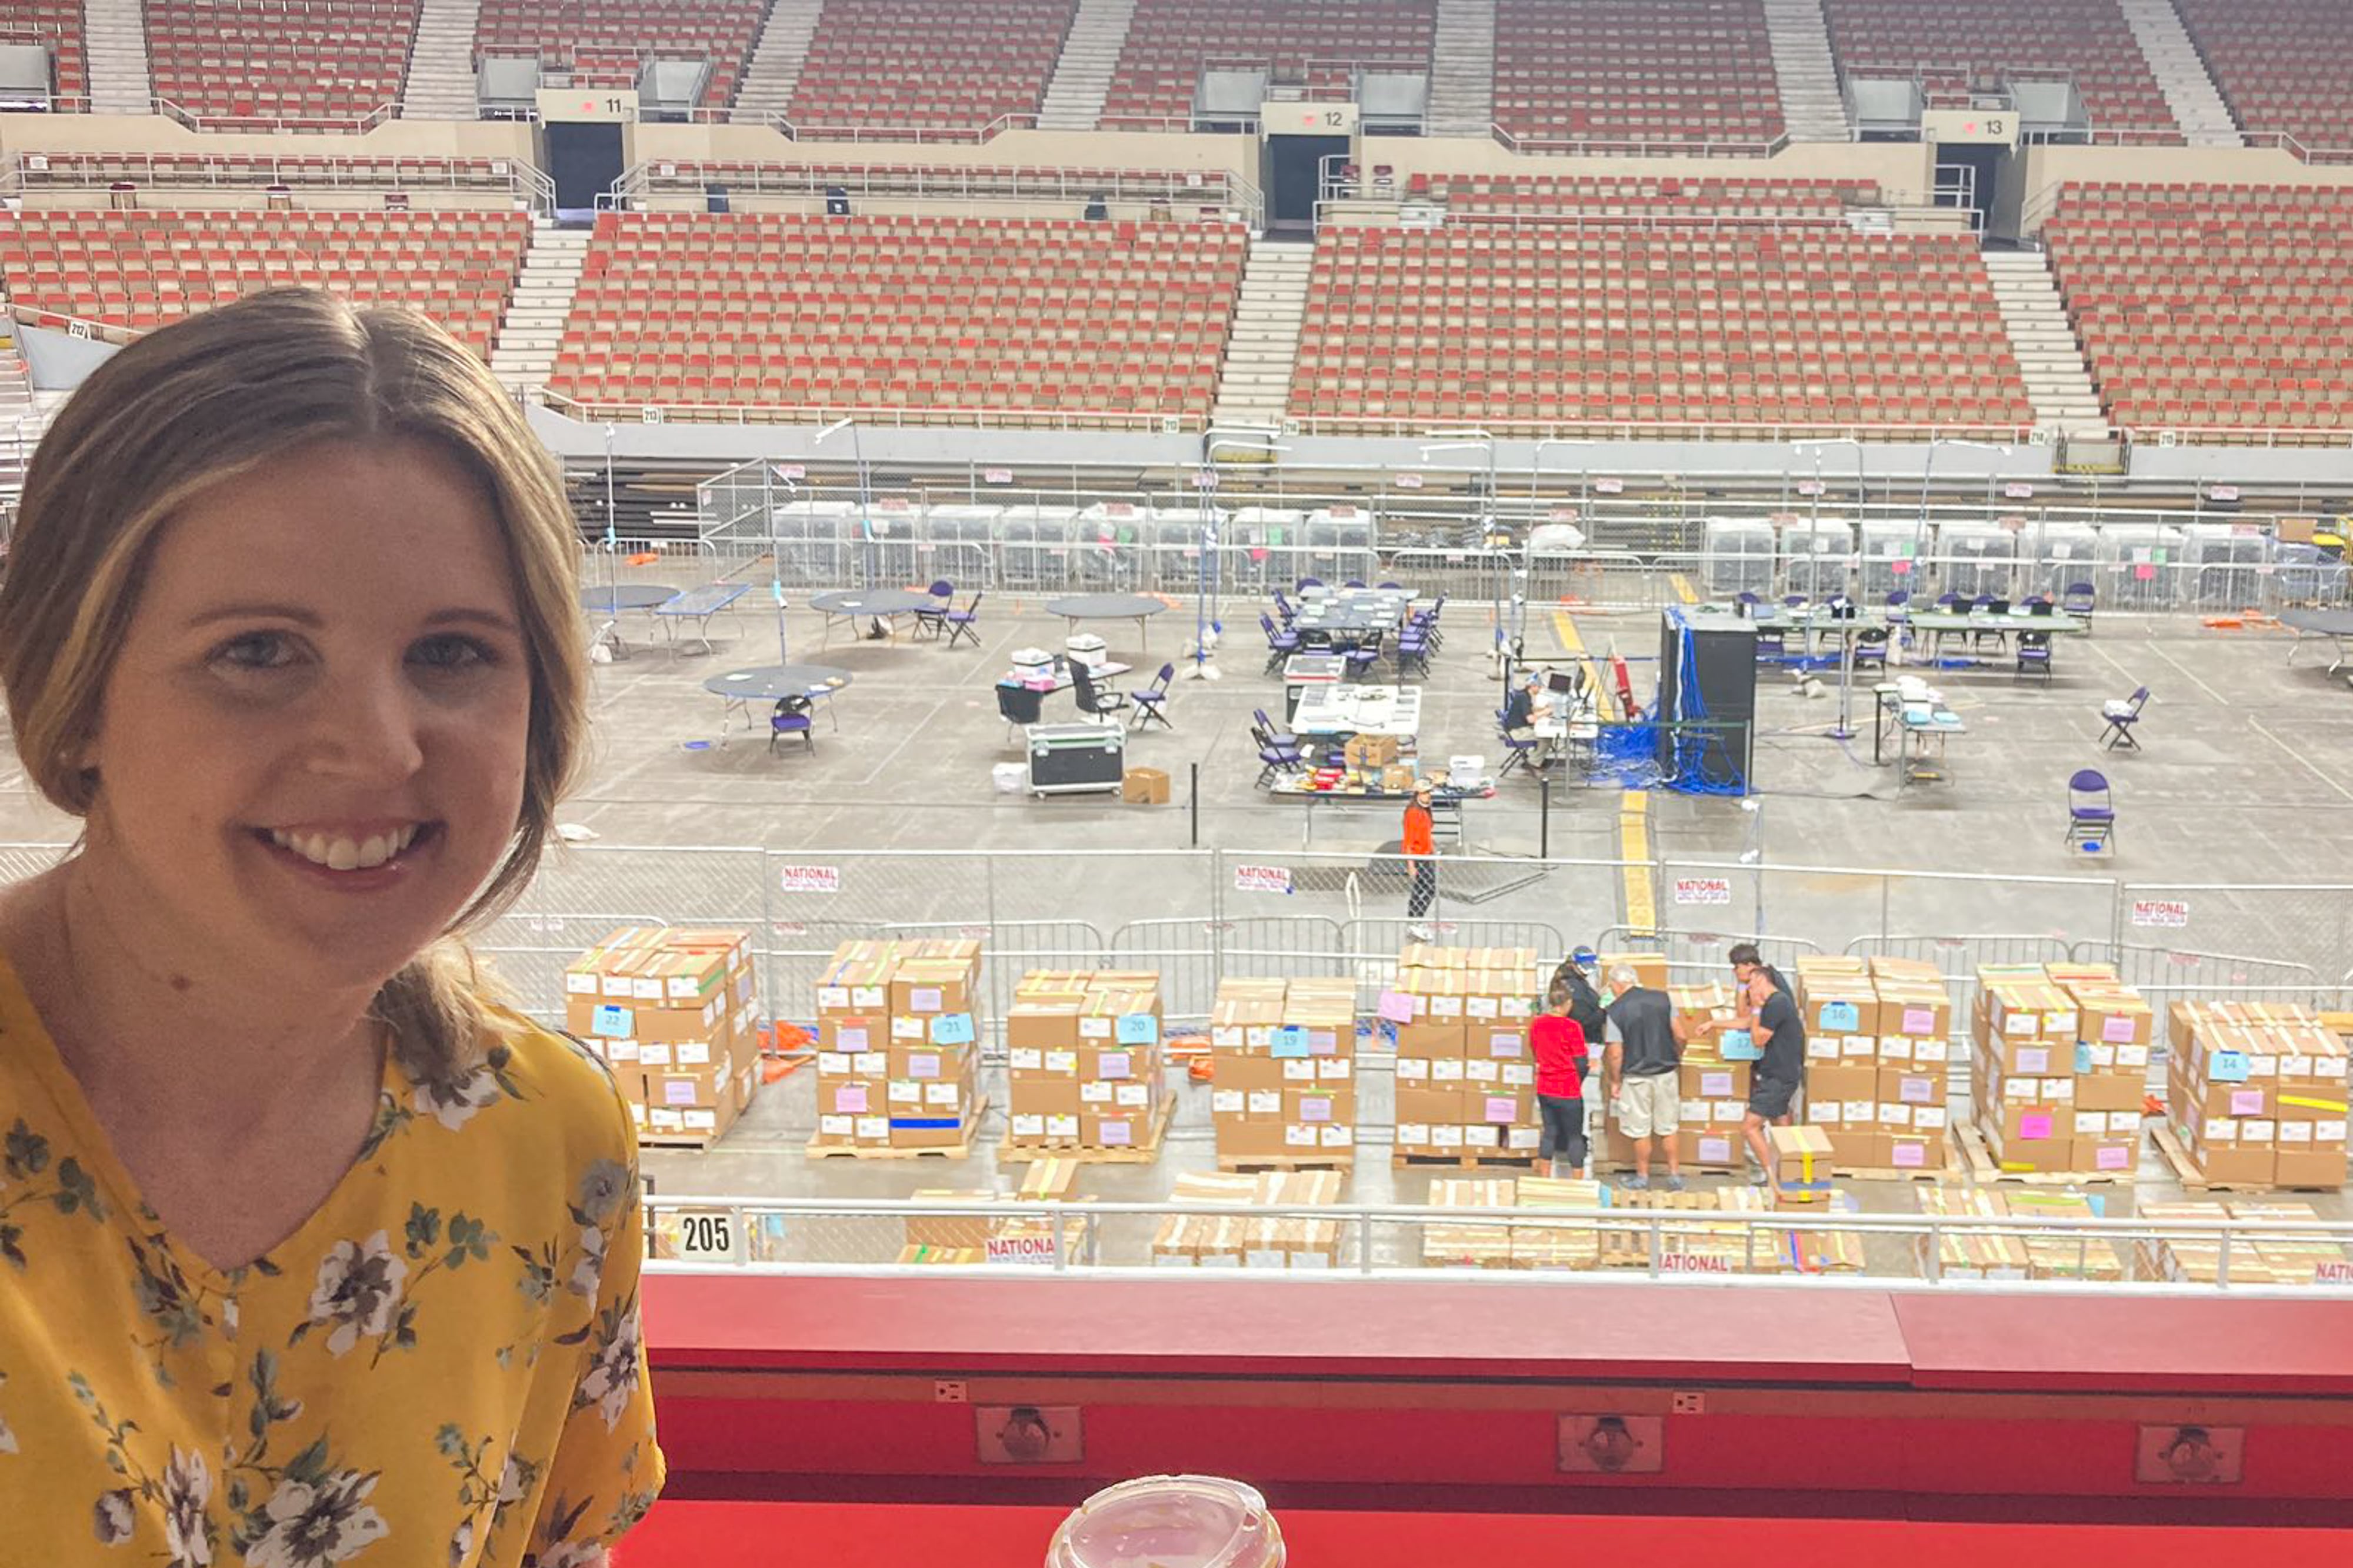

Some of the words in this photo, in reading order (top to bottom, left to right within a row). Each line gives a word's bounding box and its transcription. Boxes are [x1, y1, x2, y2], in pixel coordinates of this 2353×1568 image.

[606, 98, 621, 113] 11
[1325, 111, 1342, 126] 12
[1987, 119, 2002, 135] 13
[784, 868, 836, 879] NATIONAL
[1238, 867, 1288, 880] NATIONAL
[1677, 880, 1727, 890] NATIONAL
[2136, 902, 2187, 915] NATIONAL
[605, 1015, 619, 1026] 22
[1832, 1009, 1845, 1020] 16
[946, 1022, 961, 1033] 21
[1131, 1020, 1145, 1032] 20
[1283, 1035, 1297, 1046] 19
[2223, 1058, 2237, 1069] 14
[683, 1217, 729, 1252] 205
[988, 1238, 1055, 1255] NATIONA
